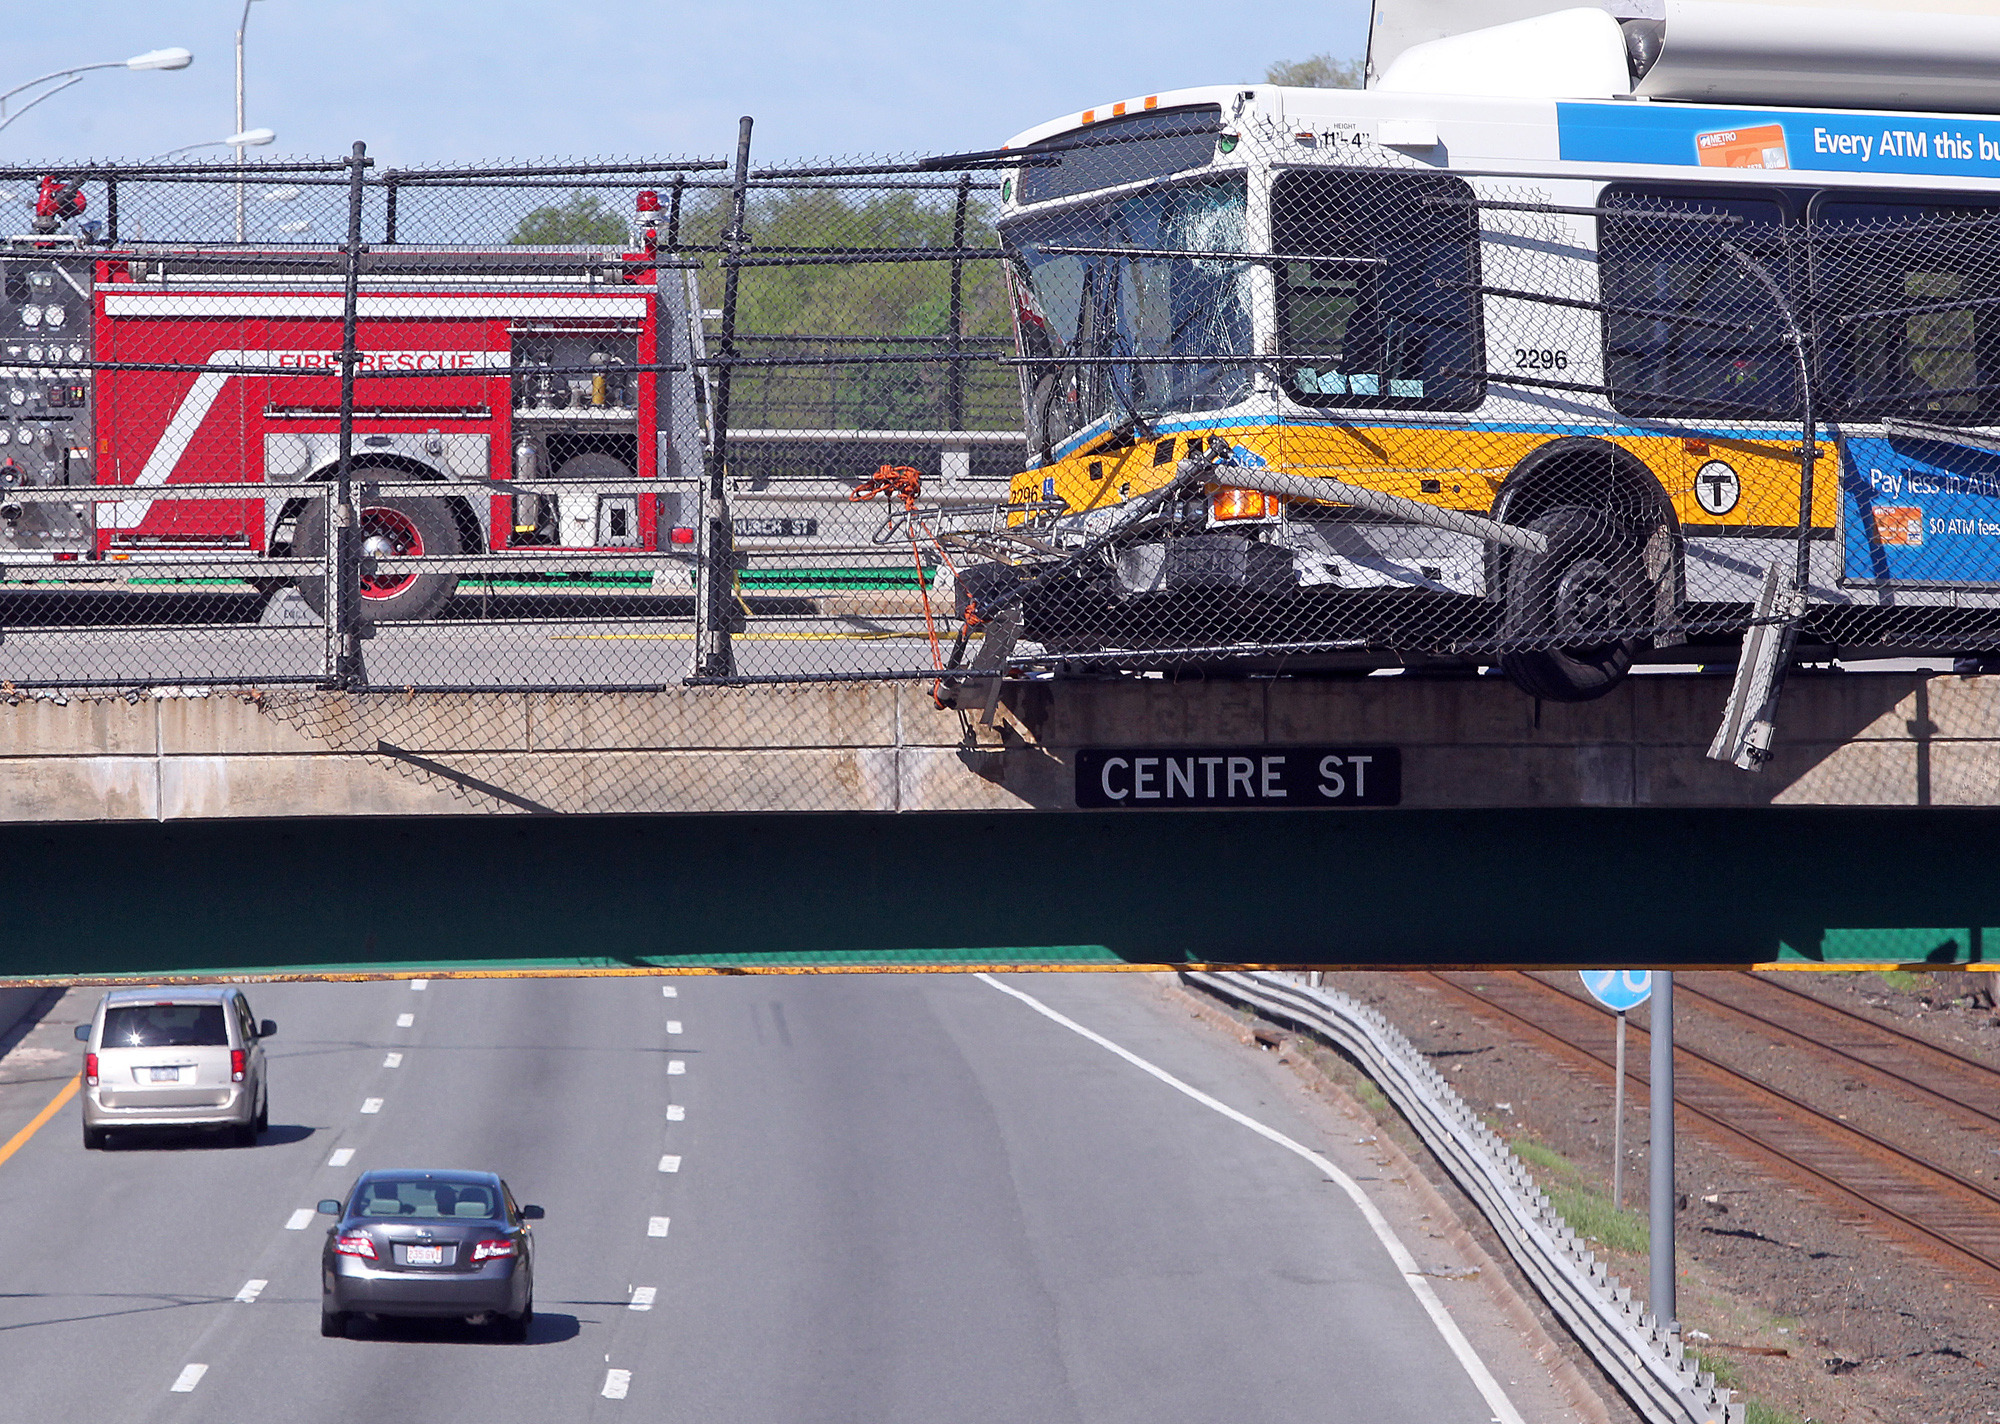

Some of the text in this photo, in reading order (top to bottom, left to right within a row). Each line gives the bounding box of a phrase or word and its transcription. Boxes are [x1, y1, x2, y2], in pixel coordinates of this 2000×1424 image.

[1710, 132, 1737, 144] METRO
[1814, 127, 1873, 162] Every
[1879, 131, 1927, 157] ATM
[1933, 132, 1973, 159] this
[279, 354, 474, 374] FIRE RESCUE
[1515, 348, 1568, 370] 2296
[1703, 475, 1731, 506] T
[1870, 468, 1902, 499] Pay
[1907, 468, 1940, 494] less
[1945, 469, 1961, 495] in
[1011, 484, 1038, 505] 2296
[792, 519, 808, 535] ST
[1929, 517, 2000, 536] $0 ATM fees
[1101, 754, 1373, 799] CENTRE ST
